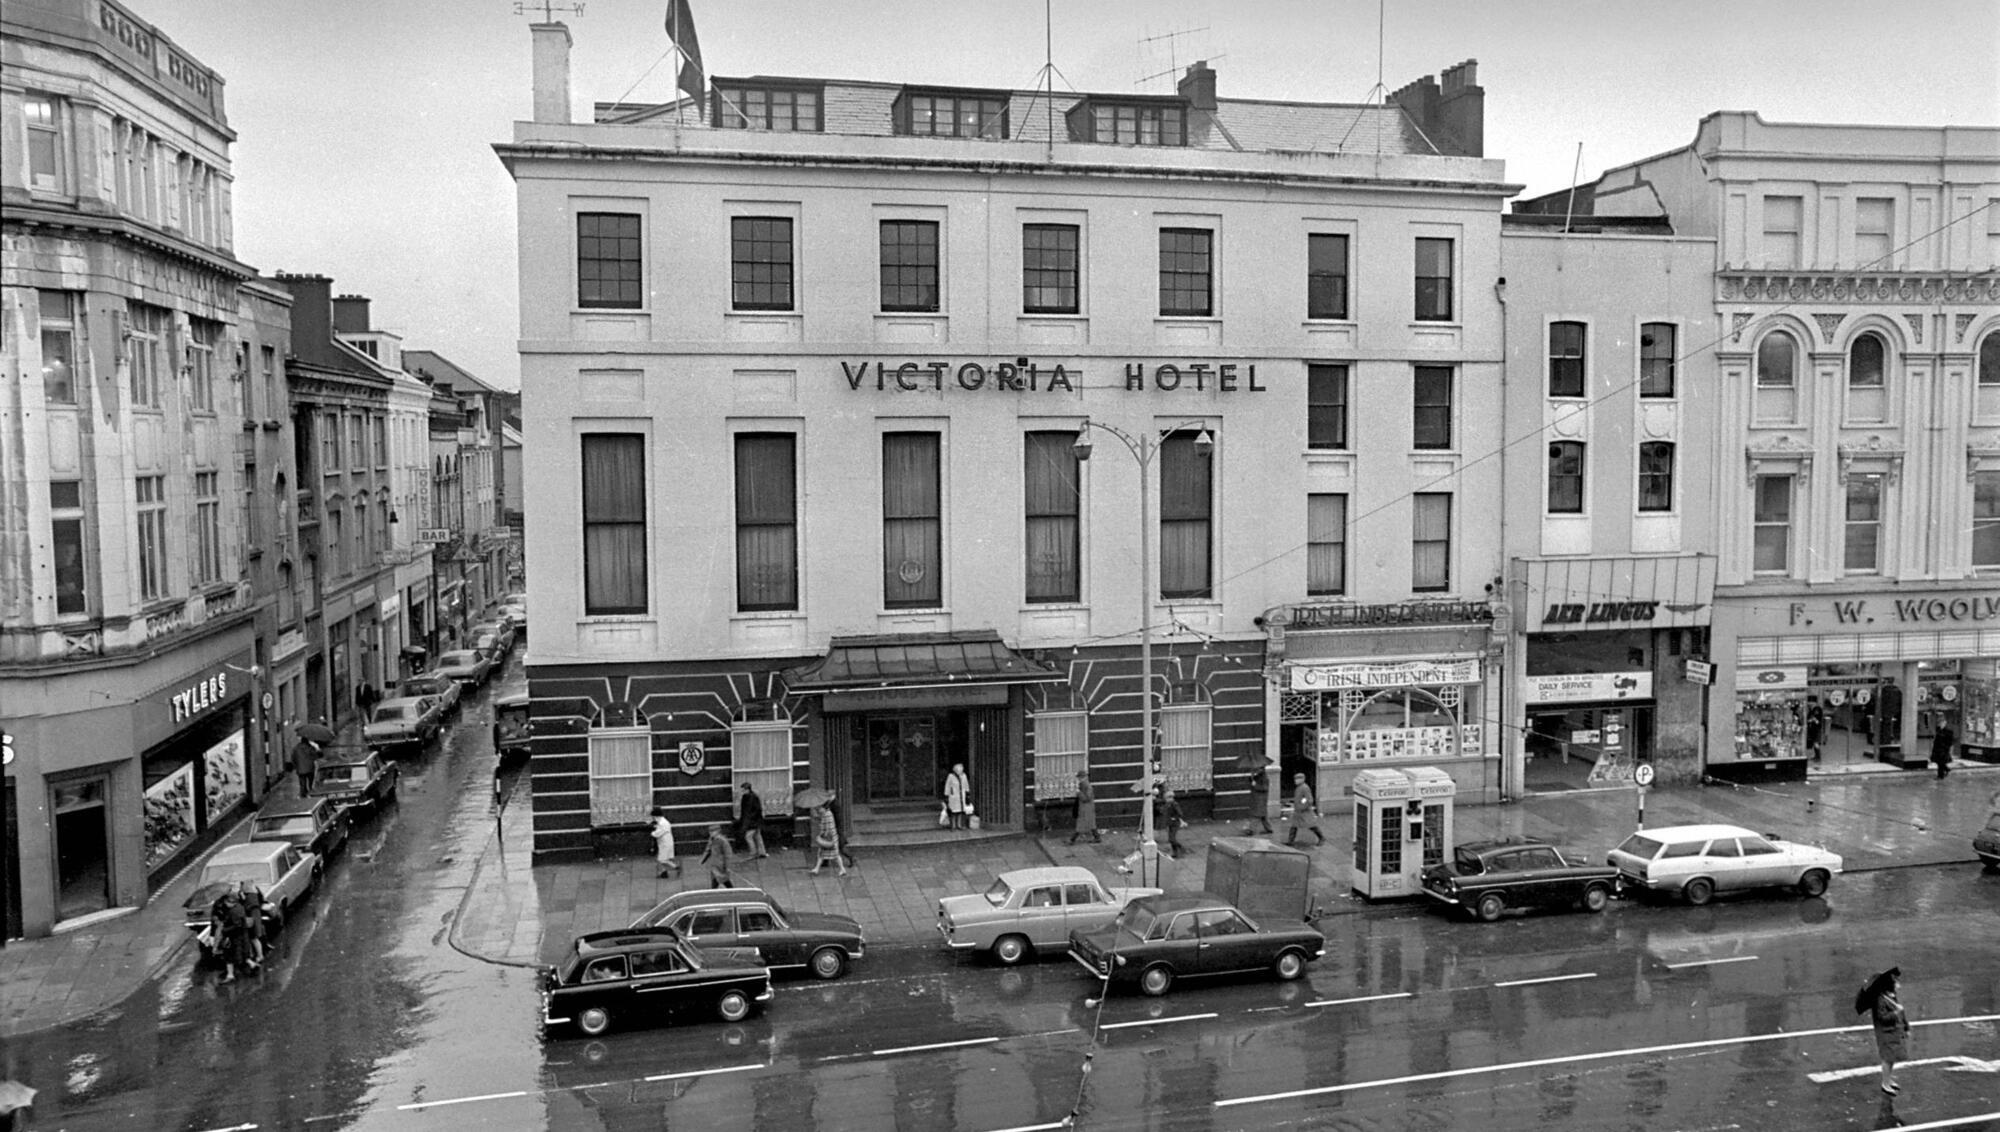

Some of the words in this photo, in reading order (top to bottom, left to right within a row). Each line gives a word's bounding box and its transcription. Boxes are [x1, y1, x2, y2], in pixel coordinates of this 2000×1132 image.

[841, 361, 1073, 392] VICTORIA
[1126, 363, 1266, 392] HOTEL
[421, 531, 446, 540] BAR
[1292, 605, 1344, 628] IRISH
[1542, 603, 1586, 624] AER
[1585, 601, 1660, 622] LINGUS
[1789, 602, 1814, 626] F.
[1835, 601, 1875, 623] W.
[1327, 674, 1361, 686] IRISH
[1367, 670, 1446, 685] INDEPENDENT
[1538, 682, 1558, 690] DAILY
[1561, 681, 1593, 689] SERVICE
[172, 671, 227, 723] TYLERS
